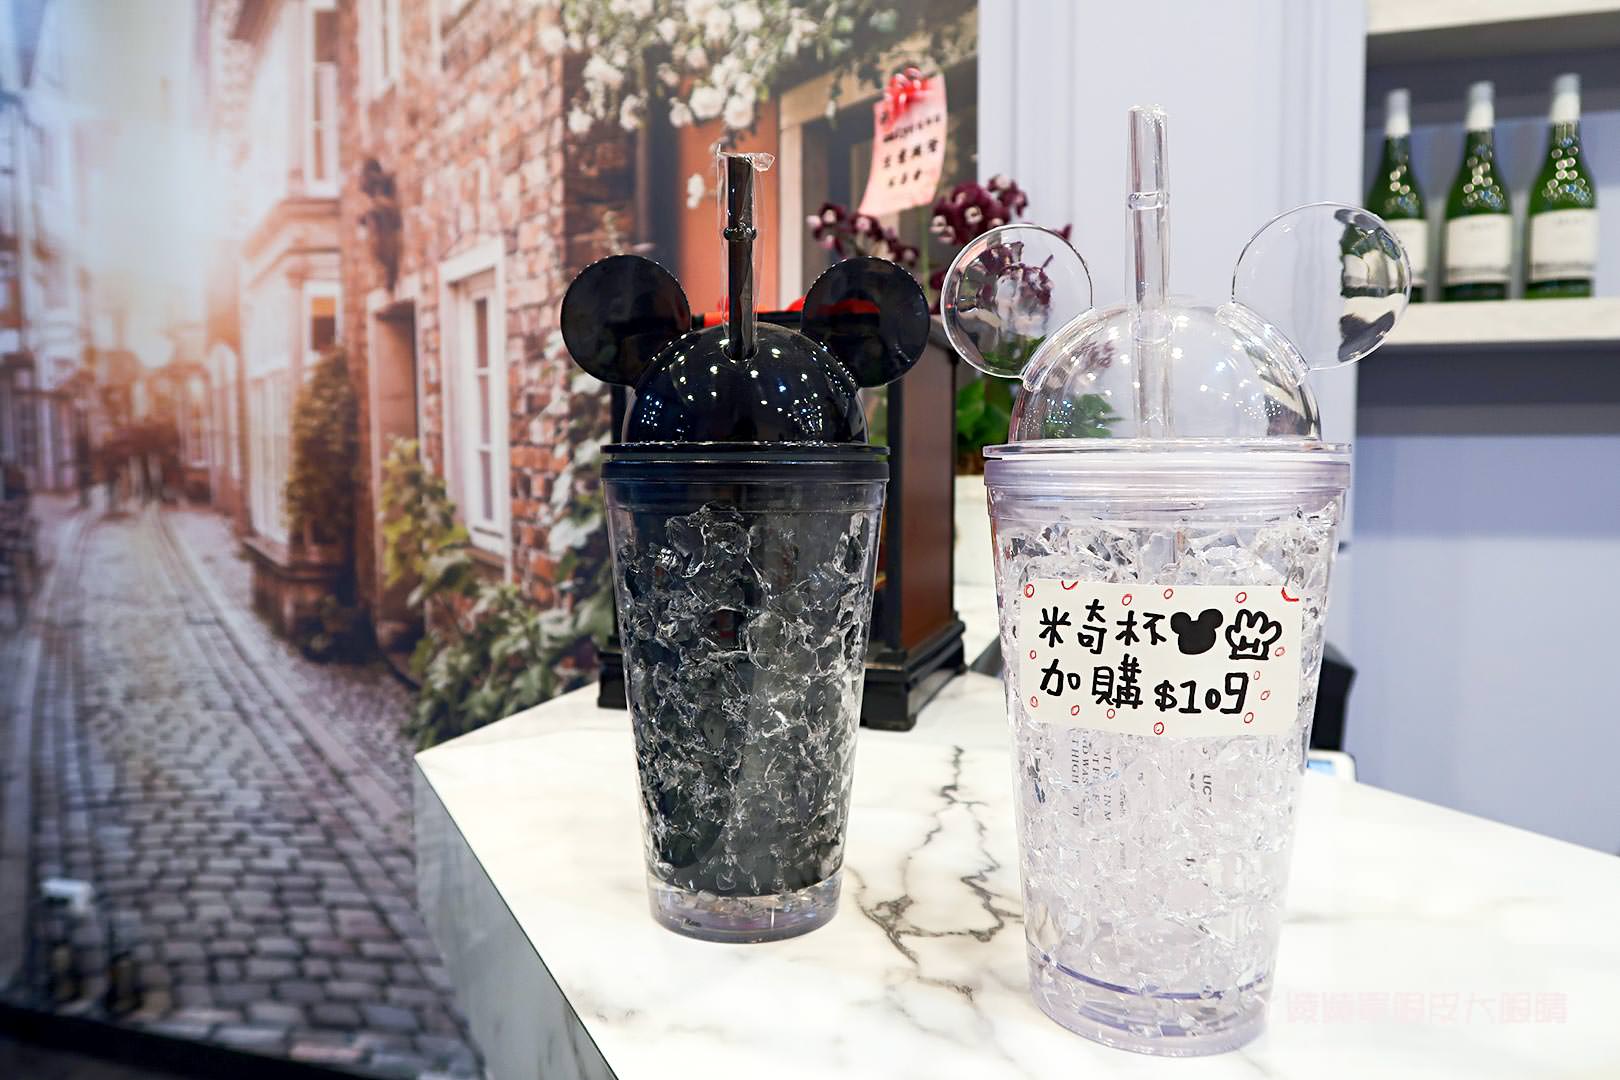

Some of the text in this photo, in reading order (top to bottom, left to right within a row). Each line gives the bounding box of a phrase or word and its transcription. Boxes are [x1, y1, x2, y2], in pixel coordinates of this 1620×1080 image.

[1038, 598, 1167, 655] 米奇杯
[1039, 653, 1249, 714] 加購 $109
